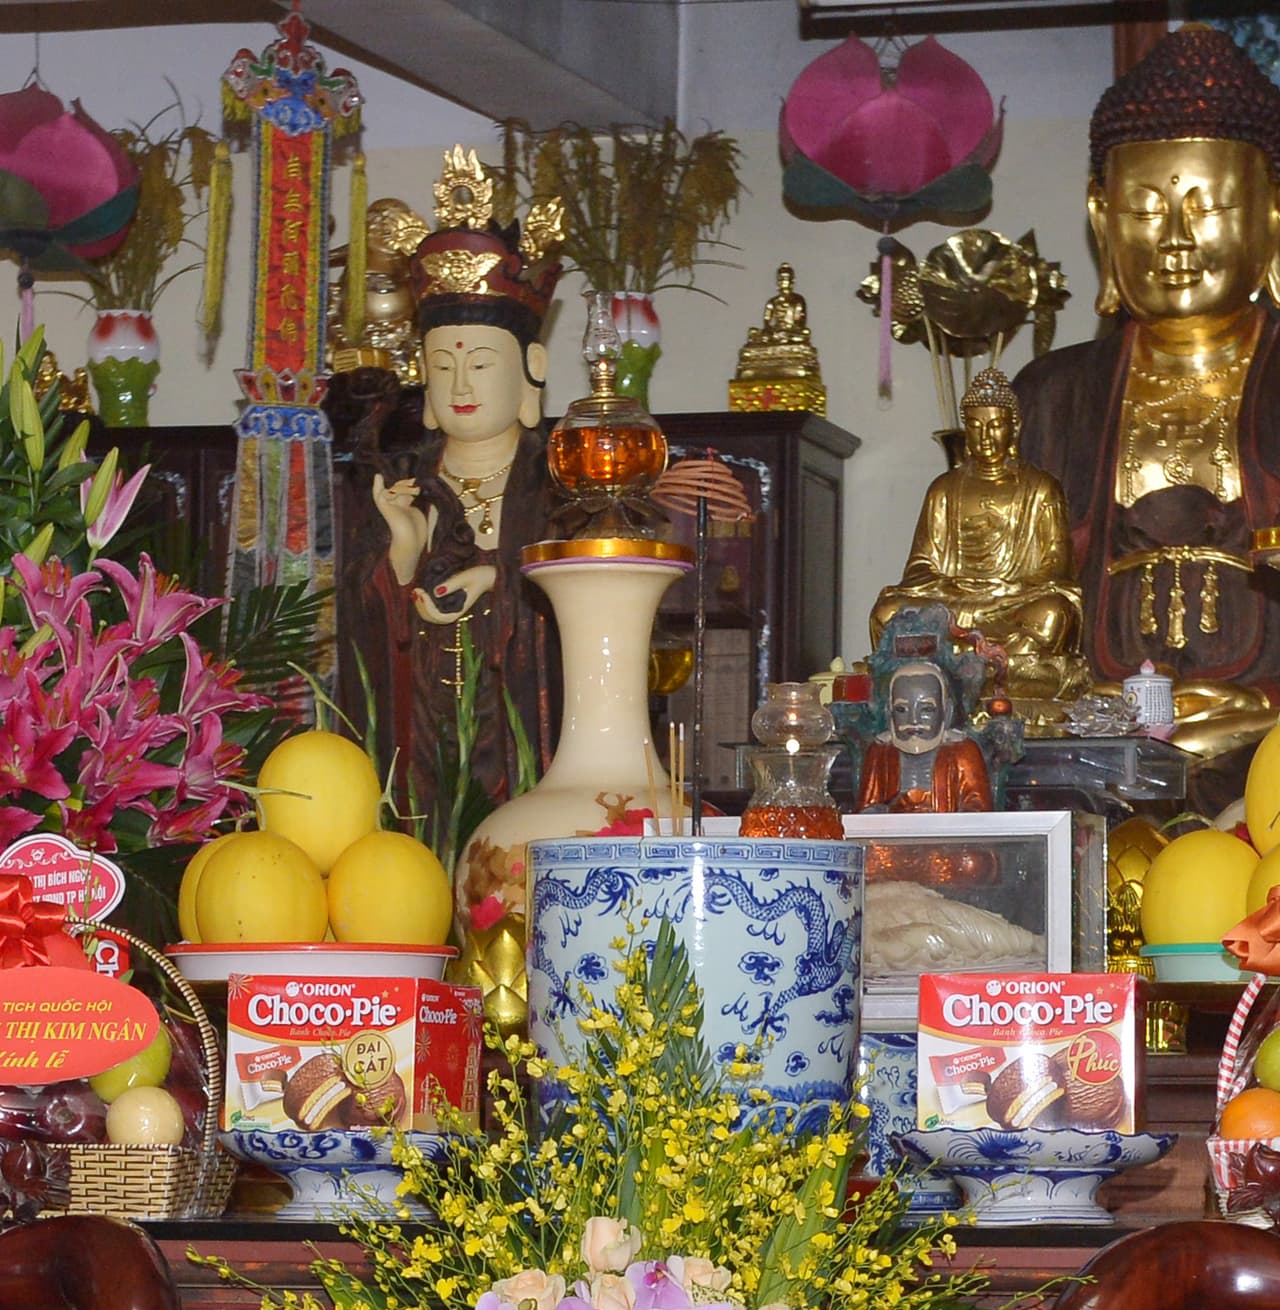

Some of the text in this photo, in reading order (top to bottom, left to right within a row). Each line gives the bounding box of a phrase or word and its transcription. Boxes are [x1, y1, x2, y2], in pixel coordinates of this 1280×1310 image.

[48, 870, 67, 887] BÍCH
[302, 983, 352, 997] ORION
[1005, 981, 1063, 995] ORION
[2, 1001, 36, 1014] TỊCH
[39, 998, 83, 1012] QUỐC
[86, 1000, 113, 1014] HỘI
[6, 1021, 41, 1044] THỊ
[43, 1021, 86, 1041] KIM
[87, 1017, 147, 1041] NGÂN
[1069, 1035, 1120, 1082] Phúc
